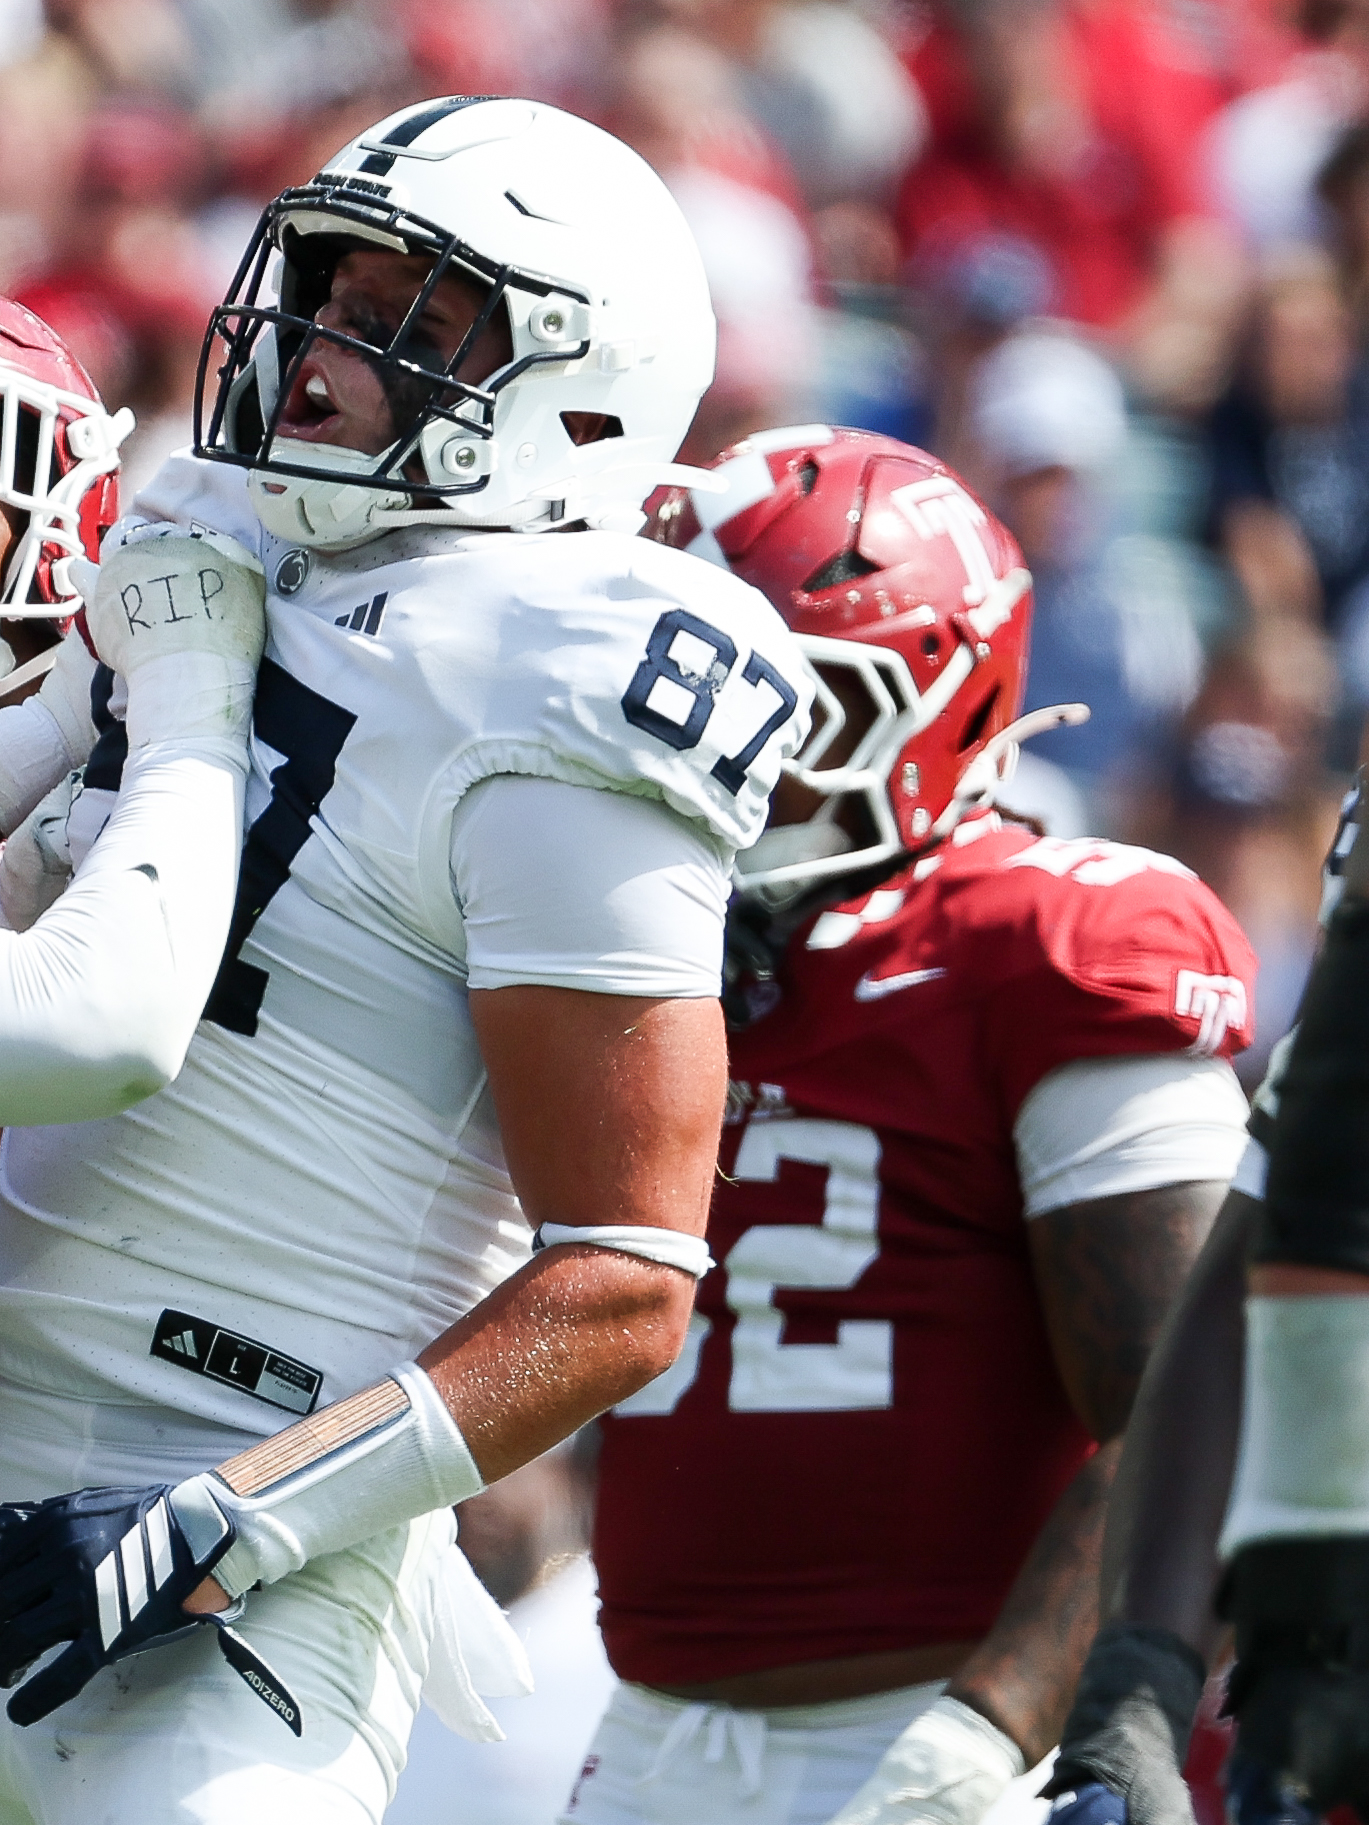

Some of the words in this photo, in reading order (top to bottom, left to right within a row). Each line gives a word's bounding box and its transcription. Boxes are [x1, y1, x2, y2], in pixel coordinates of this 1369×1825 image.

[620, 608, 799, 797] 87
[229, 1357, 239, 1374] L
[243, 1670, 295, 1722] ADIZERO
